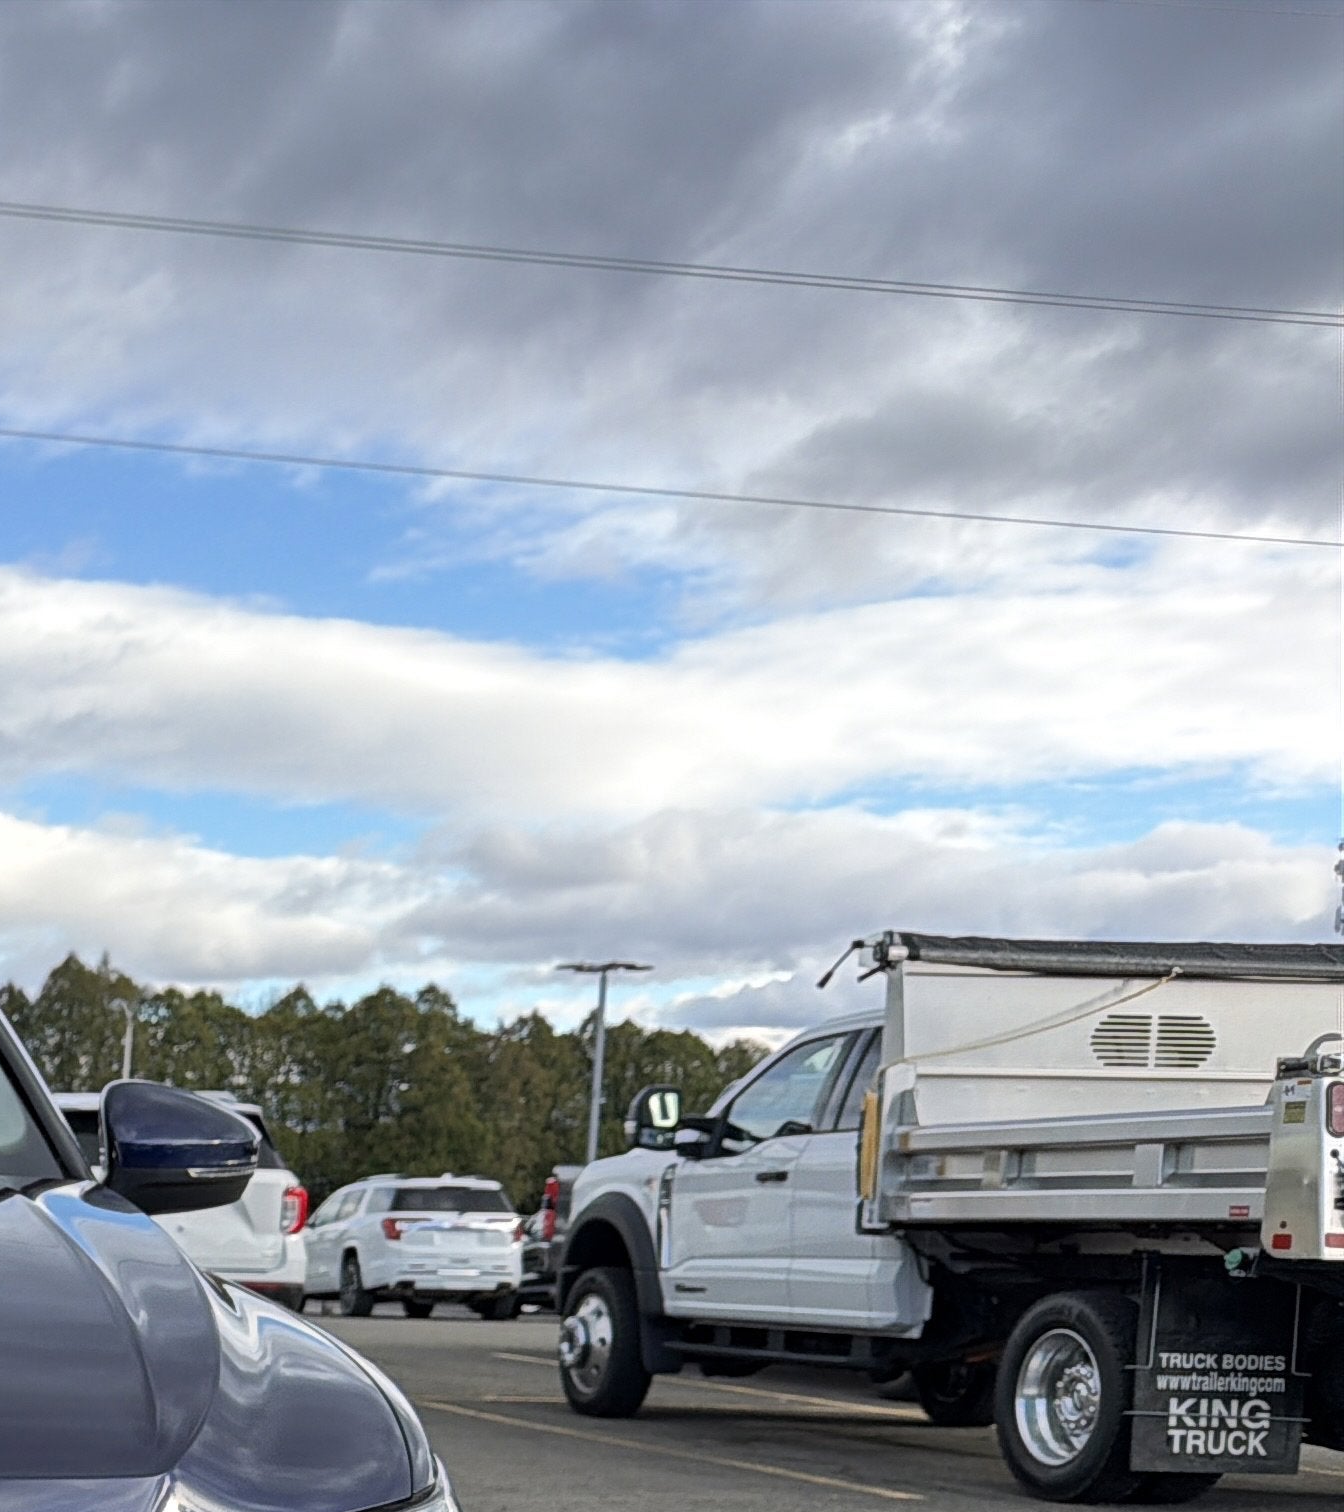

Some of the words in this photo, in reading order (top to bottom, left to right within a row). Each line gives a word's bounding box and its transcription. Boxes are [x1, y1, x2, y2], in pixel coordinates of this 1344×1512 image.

[1159, 1352, 1218, 1369] TRUCK
[1222, 1354, 1286, 1371] BODIES
[1168, 1397, 1271, 1429] KING
[1167, 1429, 1269, 1456] TRUCK
